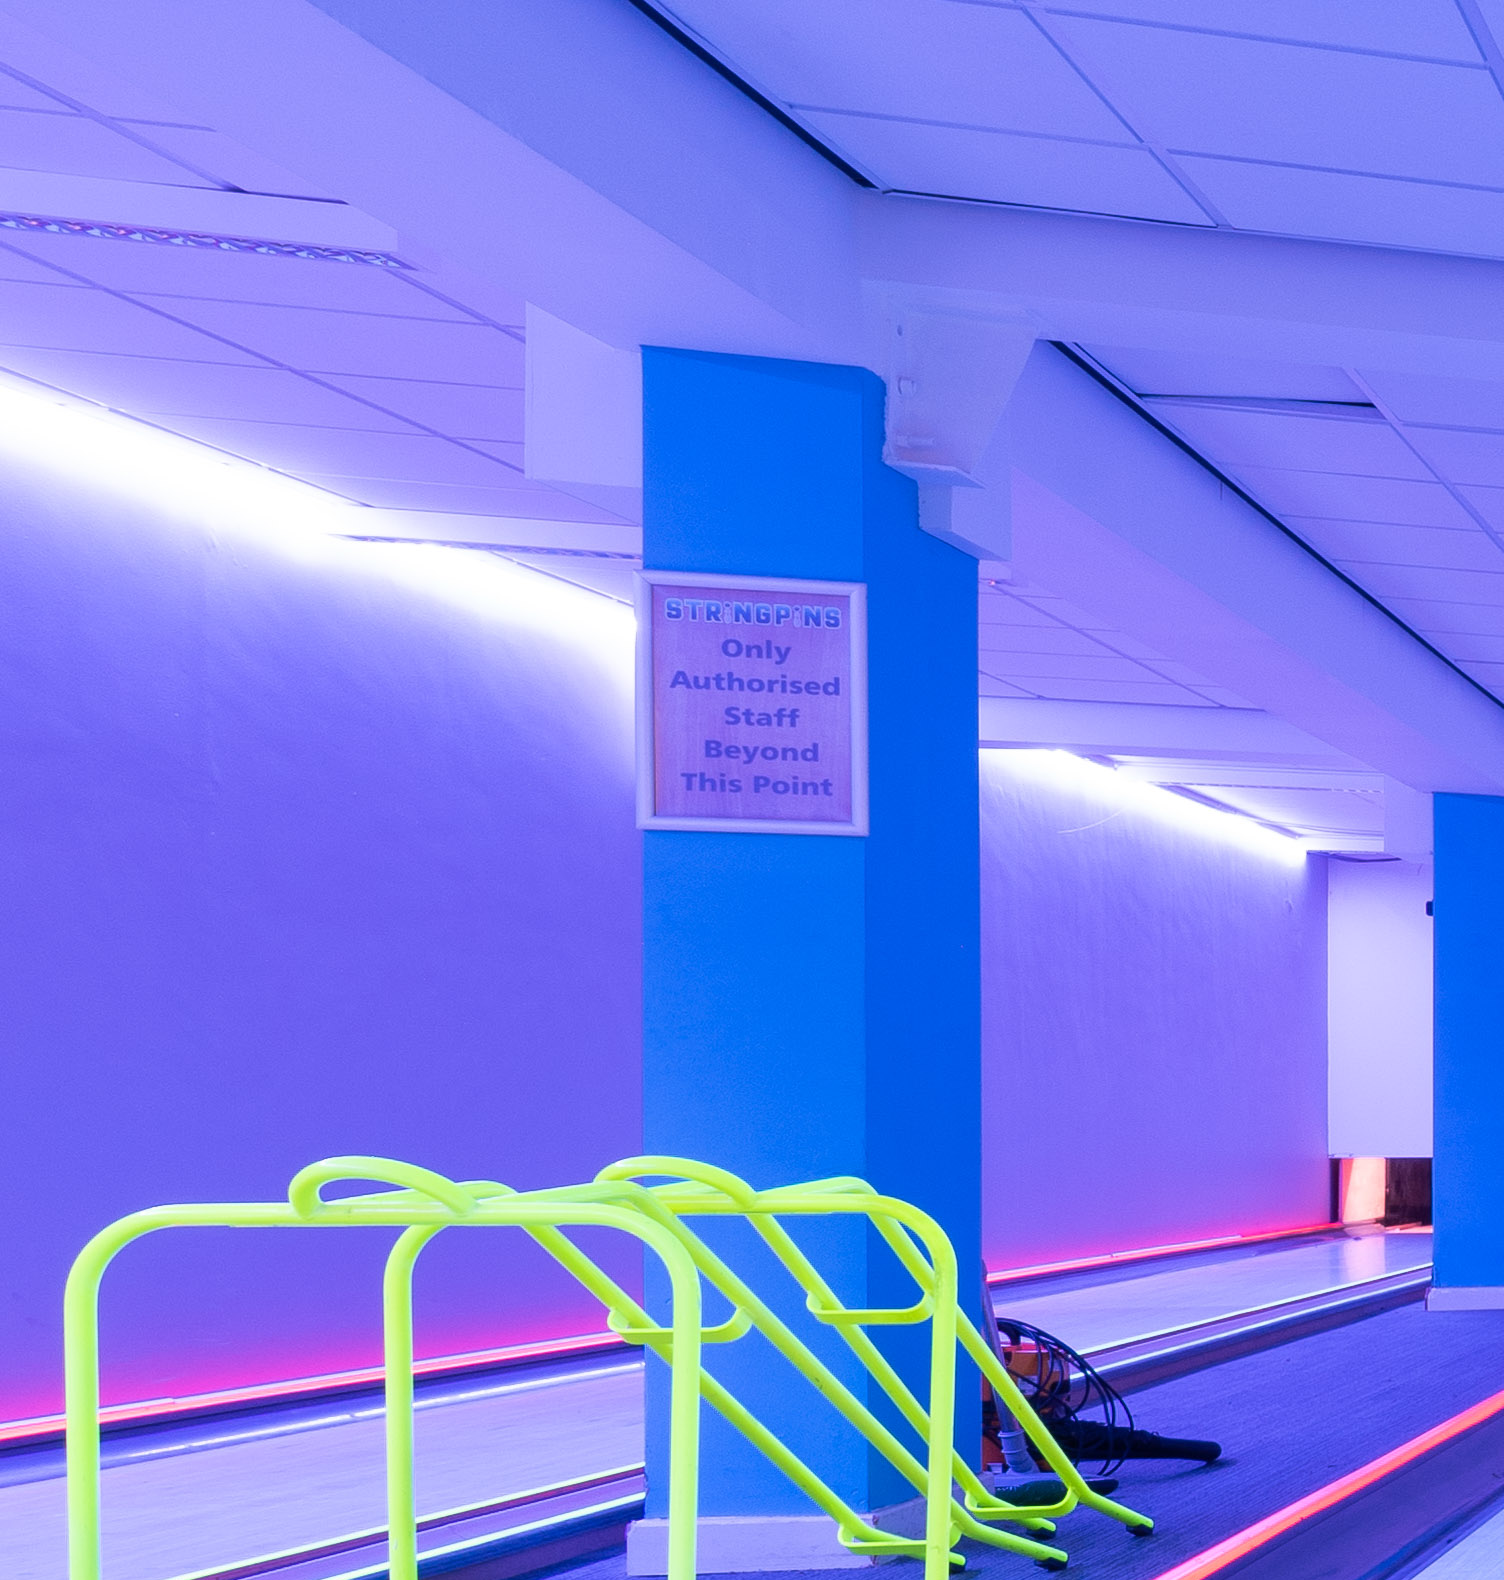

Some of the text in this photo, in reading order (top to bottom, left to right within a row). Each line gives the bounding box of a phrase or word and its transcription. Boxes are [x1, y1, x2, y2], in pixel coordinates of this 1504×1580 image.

[721, 639, 791, 664] Only
[670, 670, 840, 696] Authorised
[724, 707, 800, 727] Staff
[704, 740, 819, 763] Beyond
[681, 772, 833, 796] This Point
